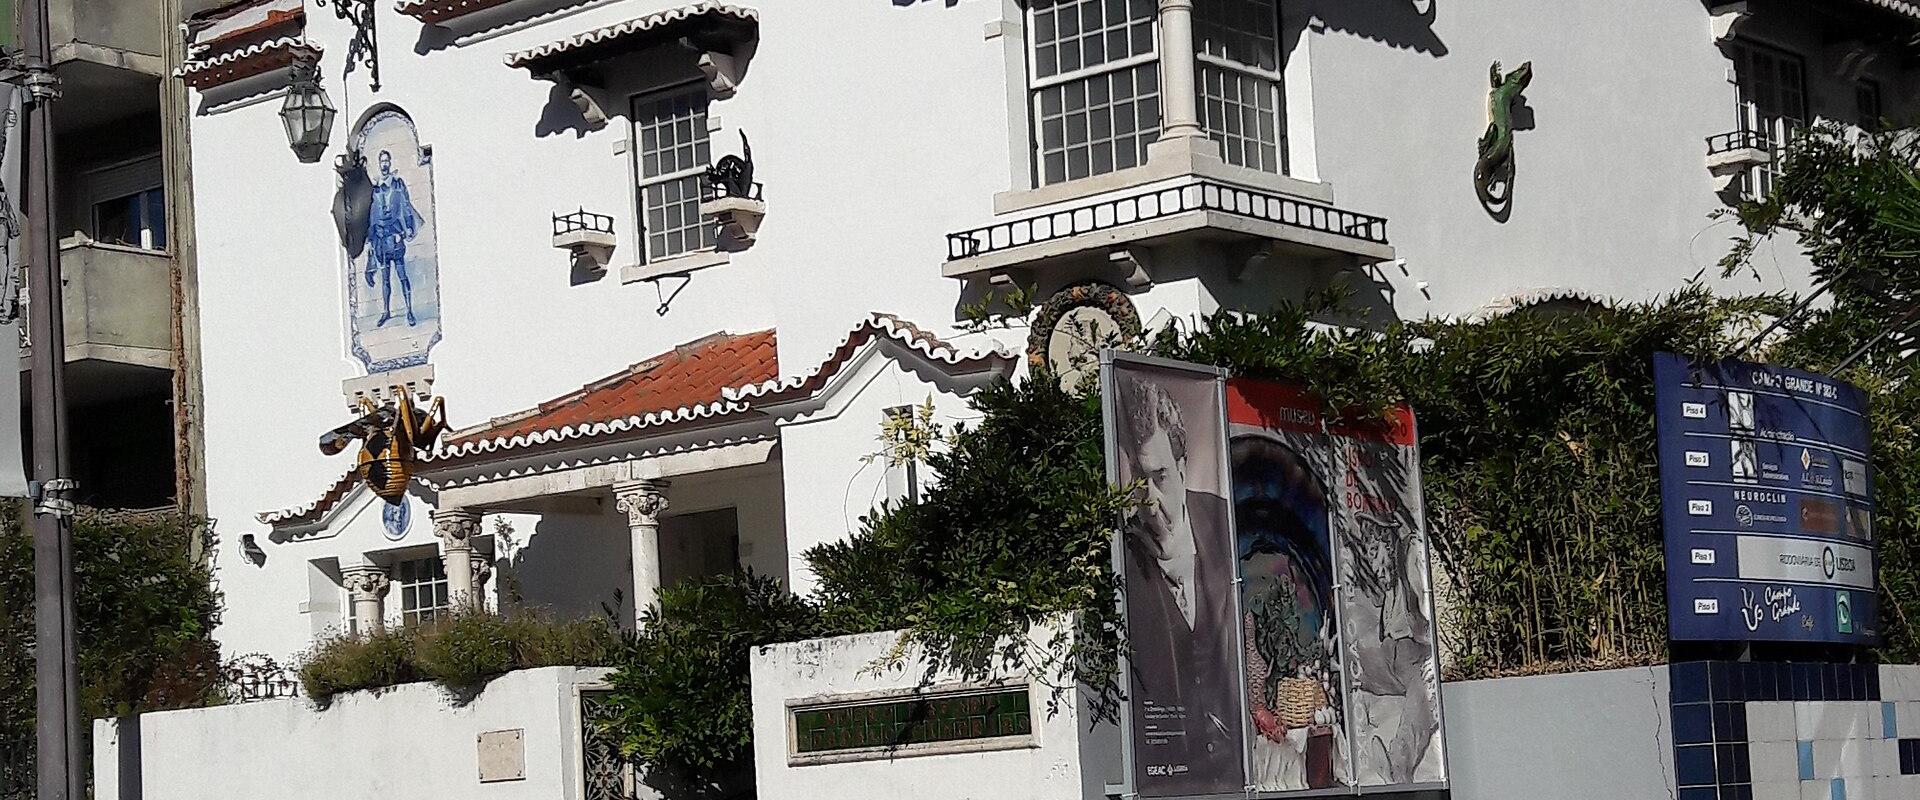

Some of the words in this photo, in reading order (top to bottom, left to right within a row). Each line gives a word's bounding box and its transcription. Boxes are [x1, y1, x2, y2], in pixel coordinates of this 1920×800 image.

[1784, 376, 1814, 393] GRANDE
[1686, 405, 1699, 415] Piso
[1733, 490, 1787, 504] NEUROCLIN
[1694, 551, 1708, 561] Piso
[1764, 586, 1792, 606] Campo
[1697, 601, 1711, 611] Piso
[1772, 594, 1802, 623] Grande
